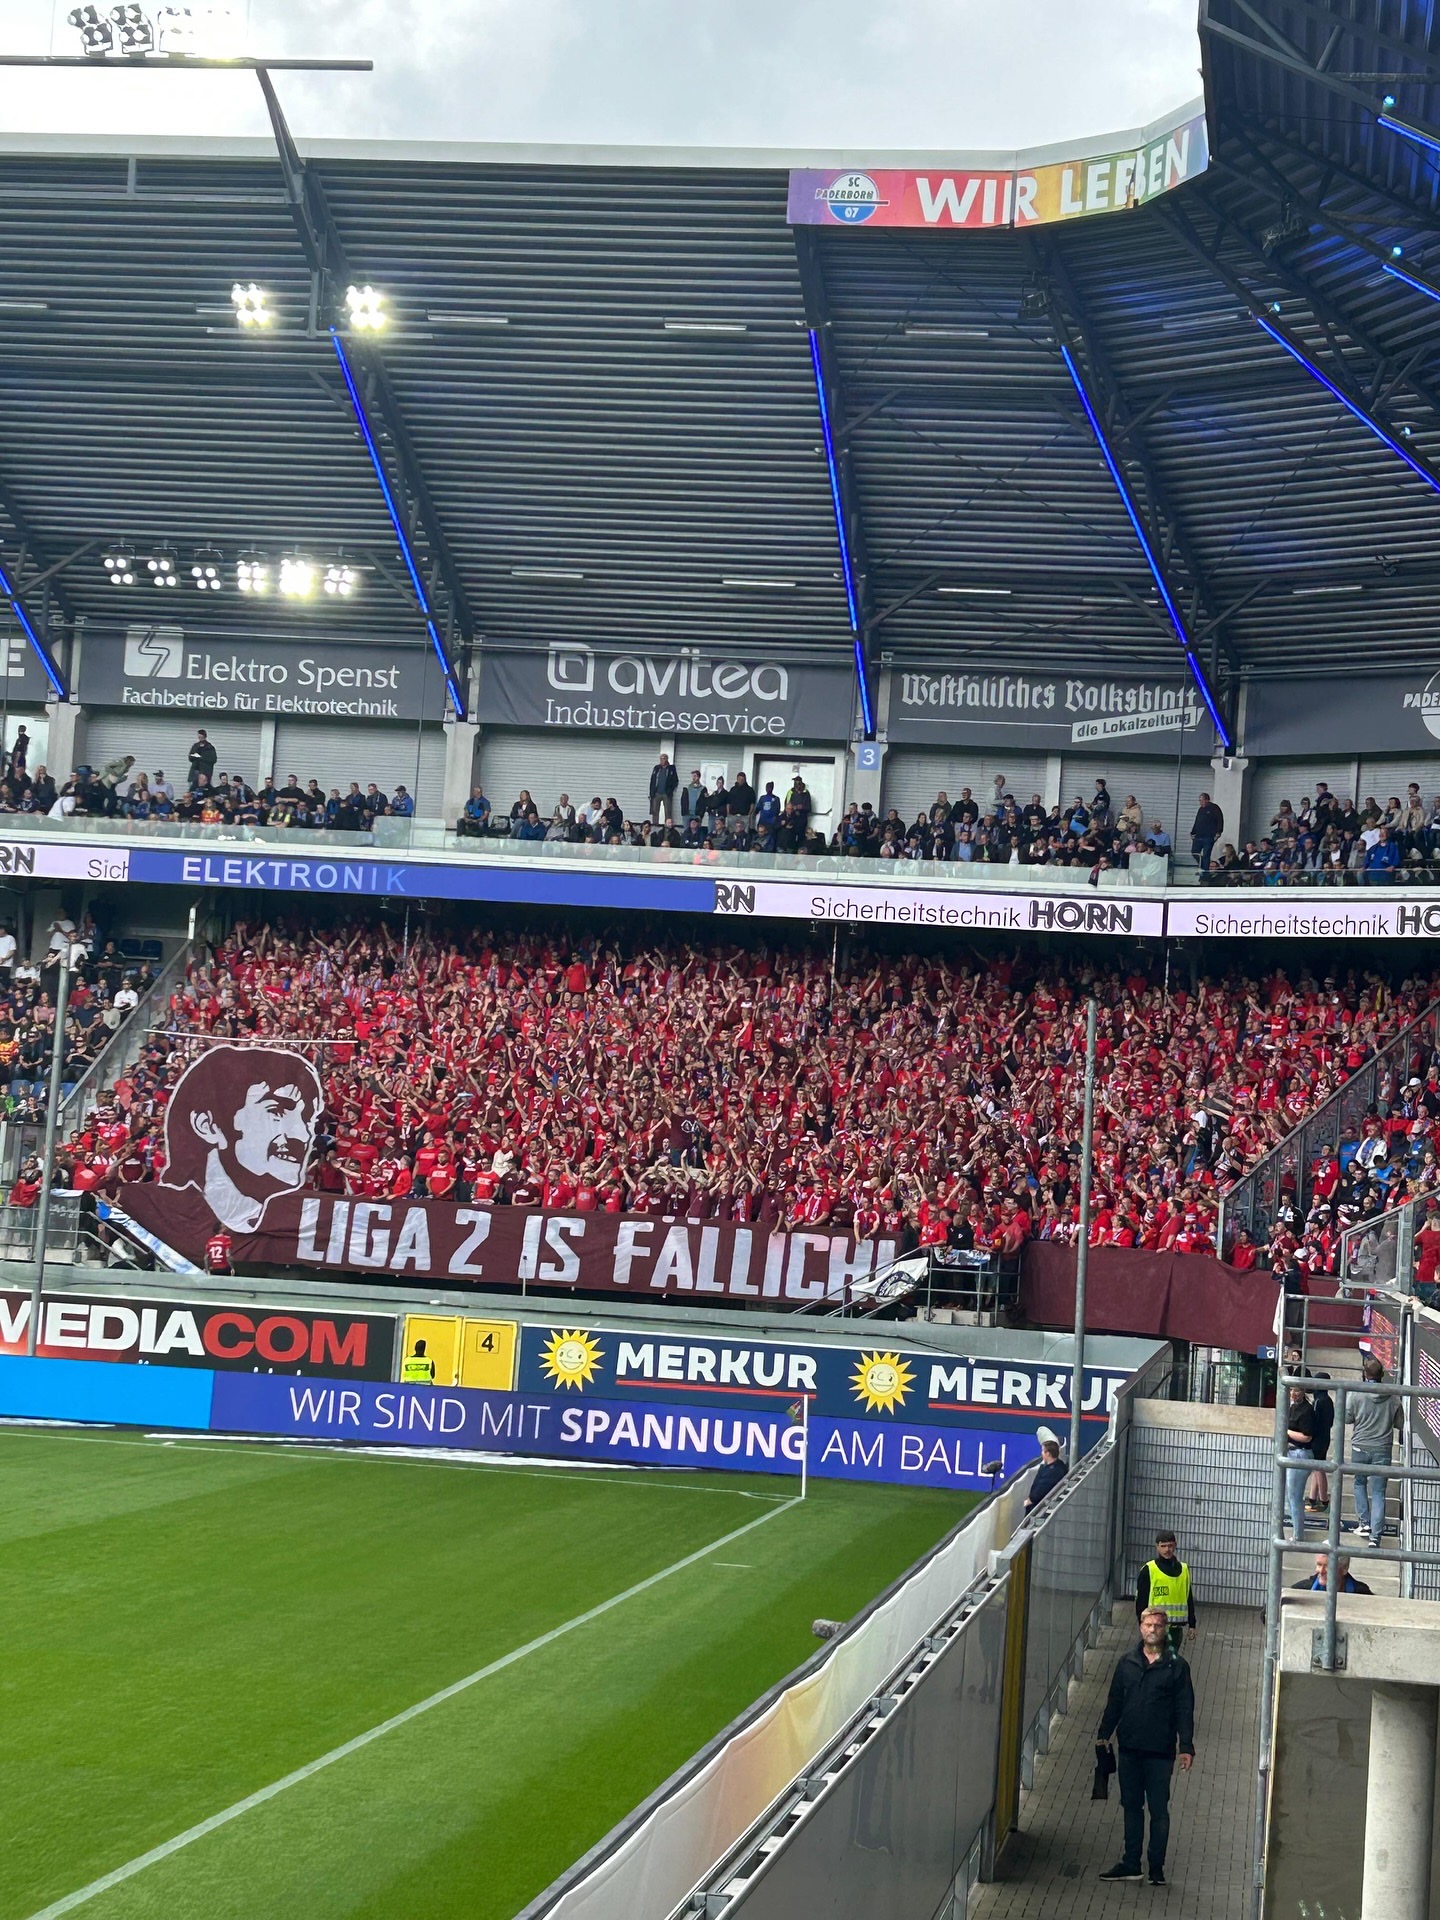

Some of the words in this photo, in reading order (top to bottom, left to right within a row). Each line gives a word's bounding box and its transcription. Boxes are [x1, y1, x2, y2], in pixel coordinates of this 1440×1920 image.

[848, 177, 861, 187] SC
[915, 176, 1039, 225] WIR
[1059, 128, 1190, 215] LEBEN
[815, 188, 874, 200] PADERBORN
[844, 207, 860, 218] 07
[186, 653, 288, 684] Elektro
[297, 658, 401, 694] Spenst
[607, 647, 789, 701] avitea
[121, 686, 229, 710] Fachbetrieb
[234, 692, 260, 710] für
[265, 694, 399, 717] Elektrotechnik
[1064, 678, 1198, 714] Volksblatt
[1402, 691, 1440, 708] PADE
[544, 698, 787, 735] Industrieservice
[1076, 723, 1098, 738] die
[1103, 711, 1192, 735] Lokalzeitung
[863, 748, 876, 767] 3
[182, 856, 408, 893] ELEKTRONIK
[810, 896, 1021, 928] Sicherheitstechnik
[1028, 900, 1133, 933] HORN
[1195, 914, 1389, 936] Sicherheitstechnik
[209, 1245, 223, 1259] 12
[296, 1197, 432, 1271] LIGA
[448, 1208, 492, 1275] 2
[518, 1215, 586, 1282] IS
[481, 1333, 494, 1352] 4
[616, 1341, 818, 1390] MERKUR
[289, 1386, 361, 1426] WIR
[373, 1393, 466, 1433] SIND
[481, 1402, 550, 1440] MIT
[560, 1407, 807, 1462] SPANNUNG
[820, 1429, 885, 1468] AM
[900, 1434, 1007, 1479] BALL!
